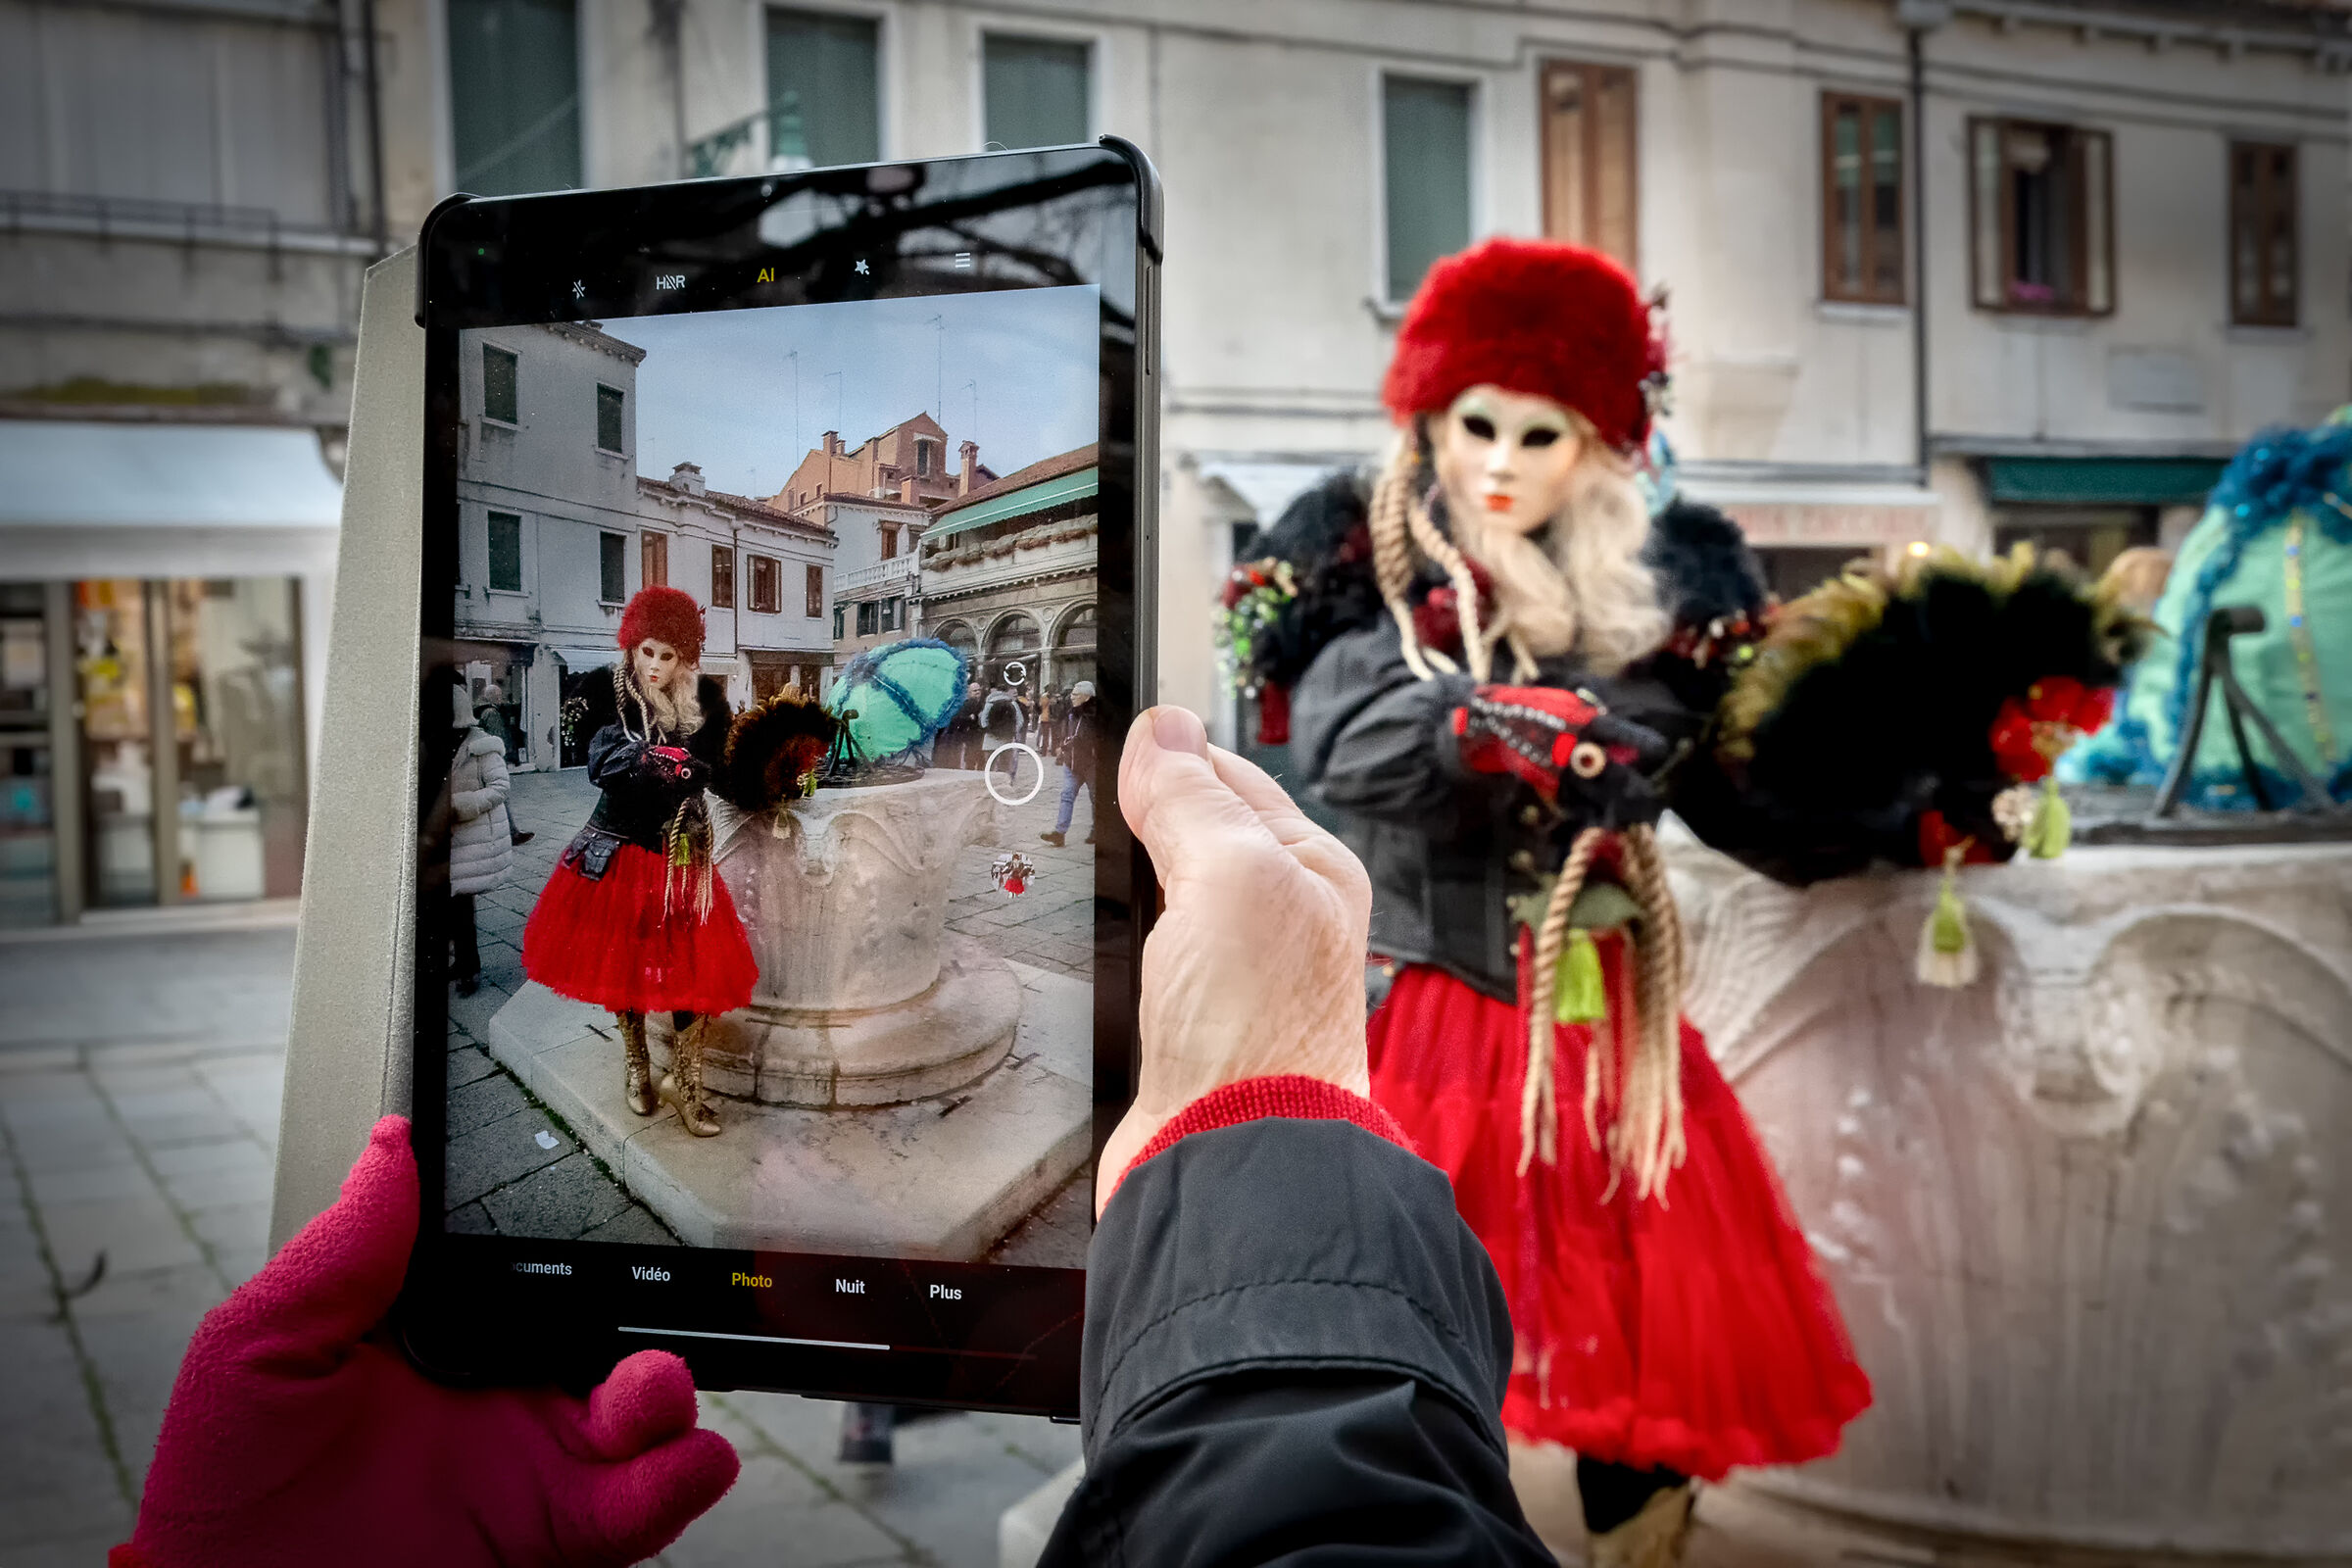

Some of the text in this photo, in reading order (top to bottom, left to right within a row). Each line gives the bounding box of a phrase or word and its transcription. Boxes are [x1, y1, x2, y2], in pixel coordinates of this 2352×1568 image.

[757, 267, 775, 283] AI
[631, 1265, 671, 1282] Vidéo
[732, 1271, 773, 1289] Photo
[835, 1278, 865, 1295] Nuit
[929, 1284, 962, 1300] Plus
